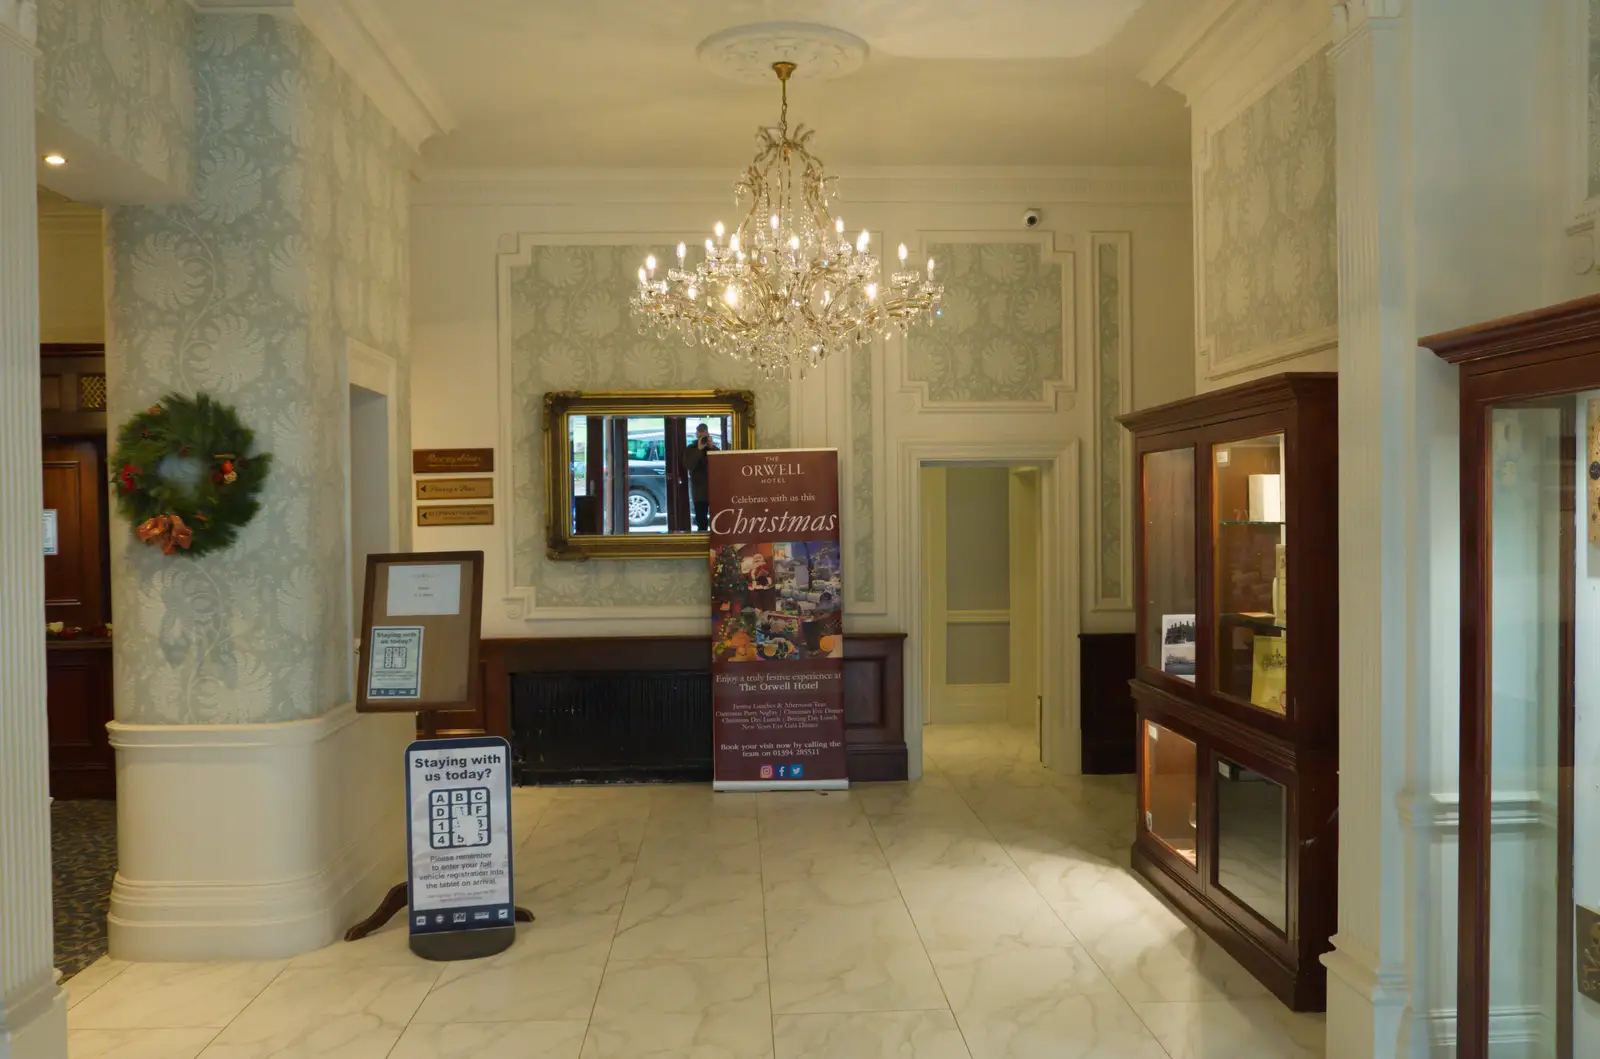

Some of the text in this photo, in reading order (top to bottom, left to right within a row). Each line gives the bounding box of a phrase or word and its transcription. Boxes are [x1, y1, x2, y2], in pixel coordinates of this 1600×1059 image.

[741, 463, 805, 477] ORWELL
[731, 495, 768, 504] Celebrate
[770, 494, 787, 502] with
[801, 493, 816, 501] this
[711, 508, 837, 535] Christmas
[376, 632, 401, 640] Staying
[716, 674, 736, 684] Enjoy
[746, 673, 763, 683] truly
[767, 672, 790, 681] festive
[792, 672, 832, 682] experience
[739, 681, 818, 691] The Orwell Hotel
[785, 701, 812, 709] Afternoon
[720, 743, 739, 751] Book
[741, 744, 757, 752] your
[793, 741, 803, 750] by
[805, 741, 828, 749] calling
[773, 749, 793, 757] 01394
[796, 748, 820, 756] 285511
[415, 754, 501, 770] Staying with
[425, 768, 492, 781] us today?
[436, 792, 483, 803] A B C
[436, 805, 483, 817] D F
[438, 821, 444, 831] 1
[437, 835, 445, 844] 4
[431, 853, 492, 863] Please remember
[461, 862, 478, 870] your
[480, 860, 493, 868] full
[420, 872, 446, 881] vehicle
[447, 870, 488, 879] registration
